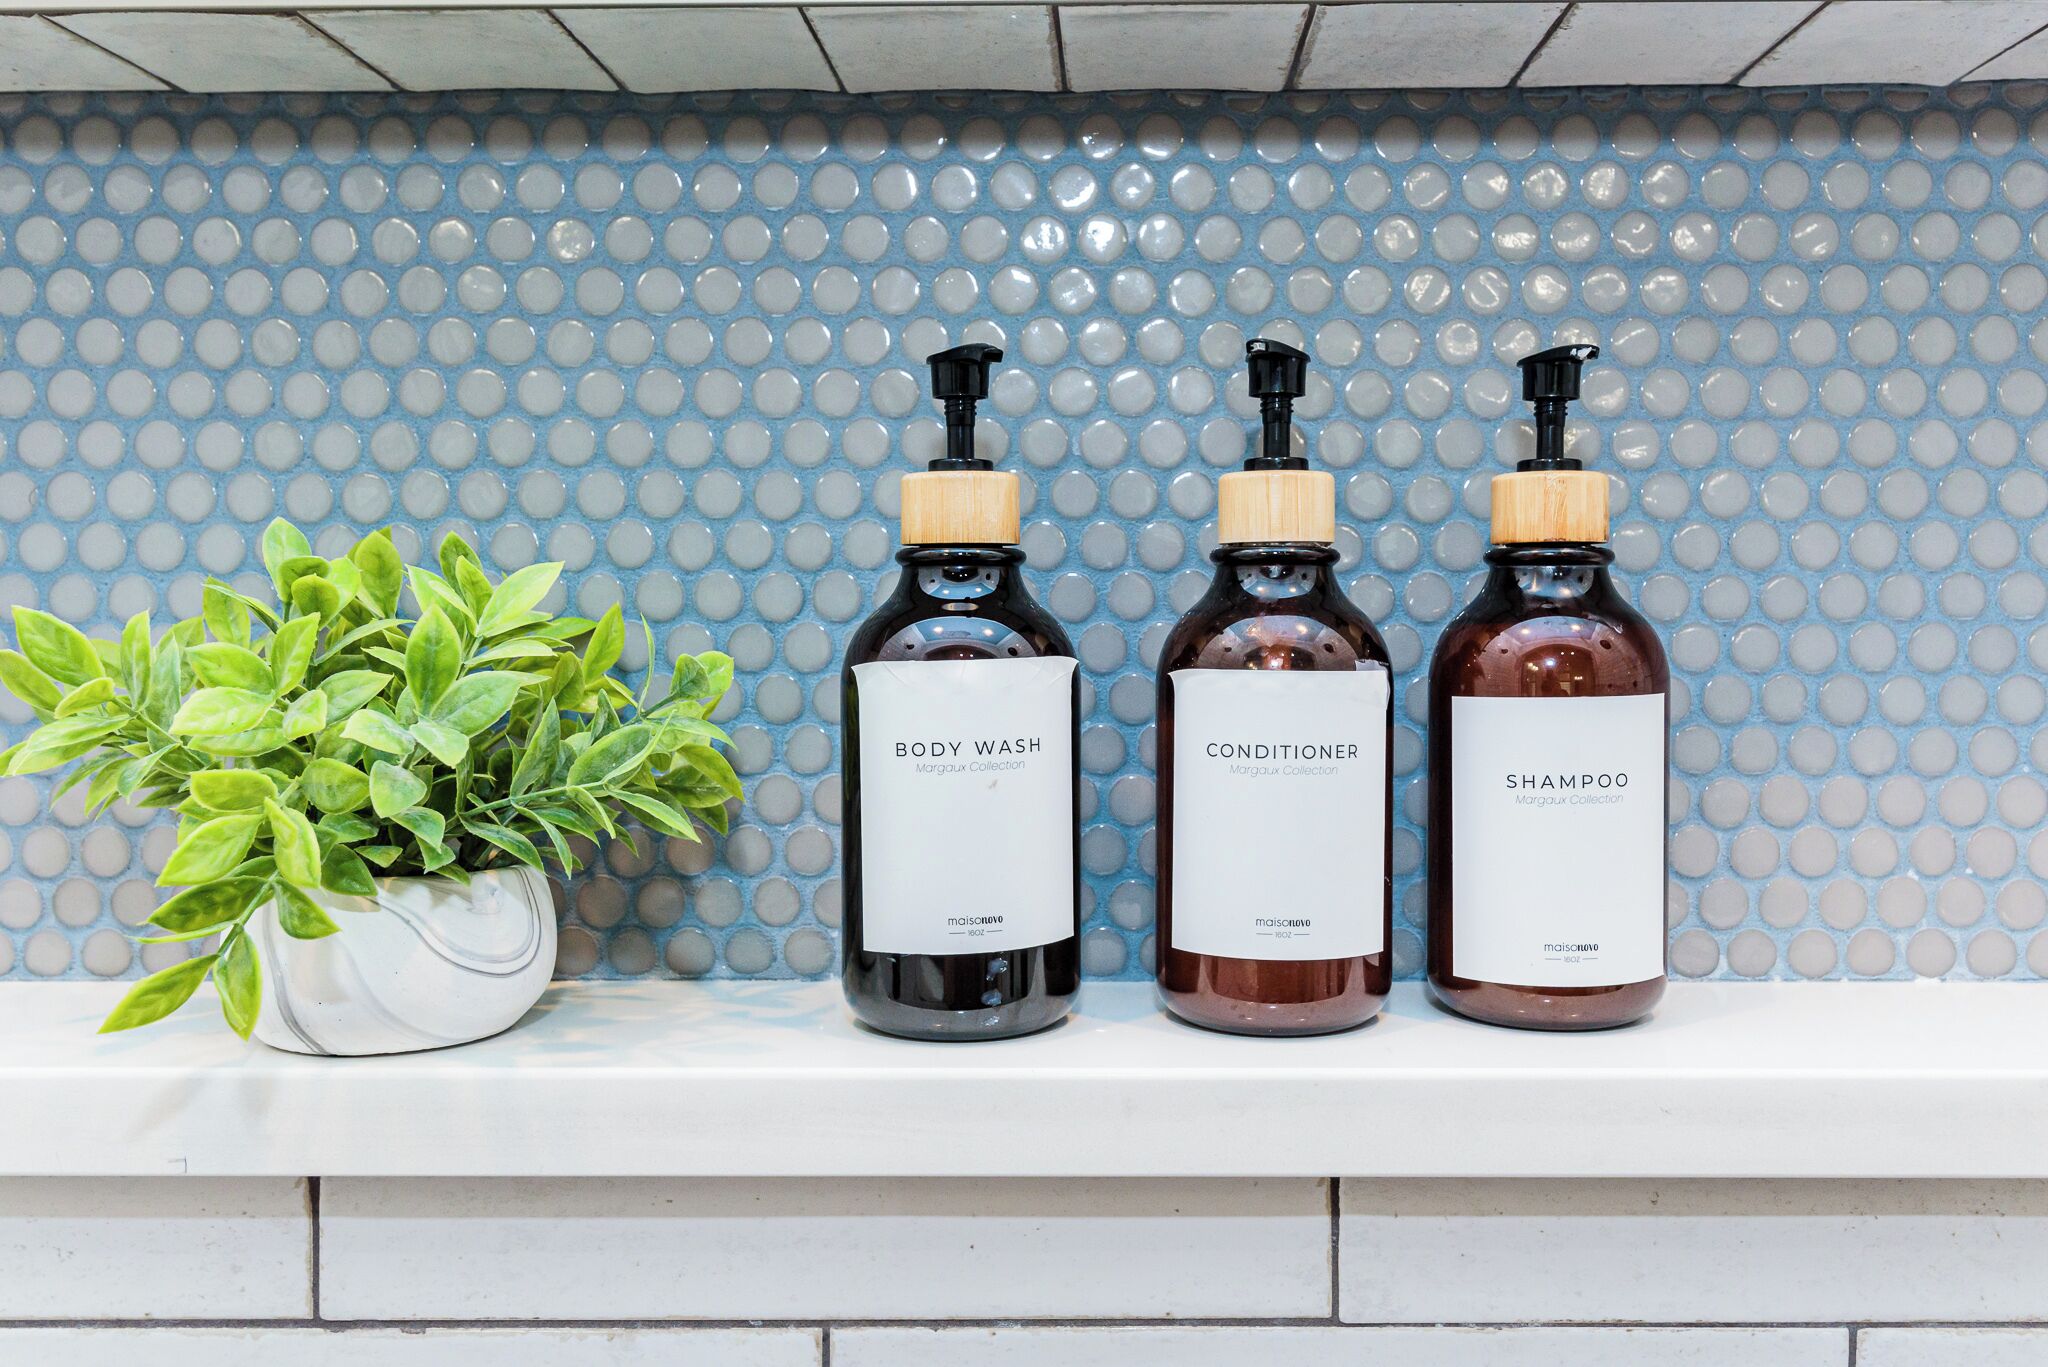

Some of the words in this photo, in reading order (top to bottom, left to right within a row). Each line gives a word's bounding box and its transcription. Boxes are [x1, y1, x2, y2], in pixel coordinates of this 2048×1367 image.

[895, 742, 962, 757] BODY
[974, 737, 1041, 756] WASH
[1206, 743, 1359, 760] CONDITIONER
[915, 762, 966, 776] Margaux
[969, 760, 1026, 773] Collection
[1229, 764, 1280, 778] Margaux
[1282, 764, 1339, 776] Collection
[1506, 773, 1628, 789] SHAMPOO
[1515, 794, 1566, 808] Margaux
[1569, 793, 1624, 805] Collection
[947, 915, 1004, 926] maisonovo
[1255, 917, 1311, 927] maisonovo
[1543, 942, 1599, 952] maisonovo
